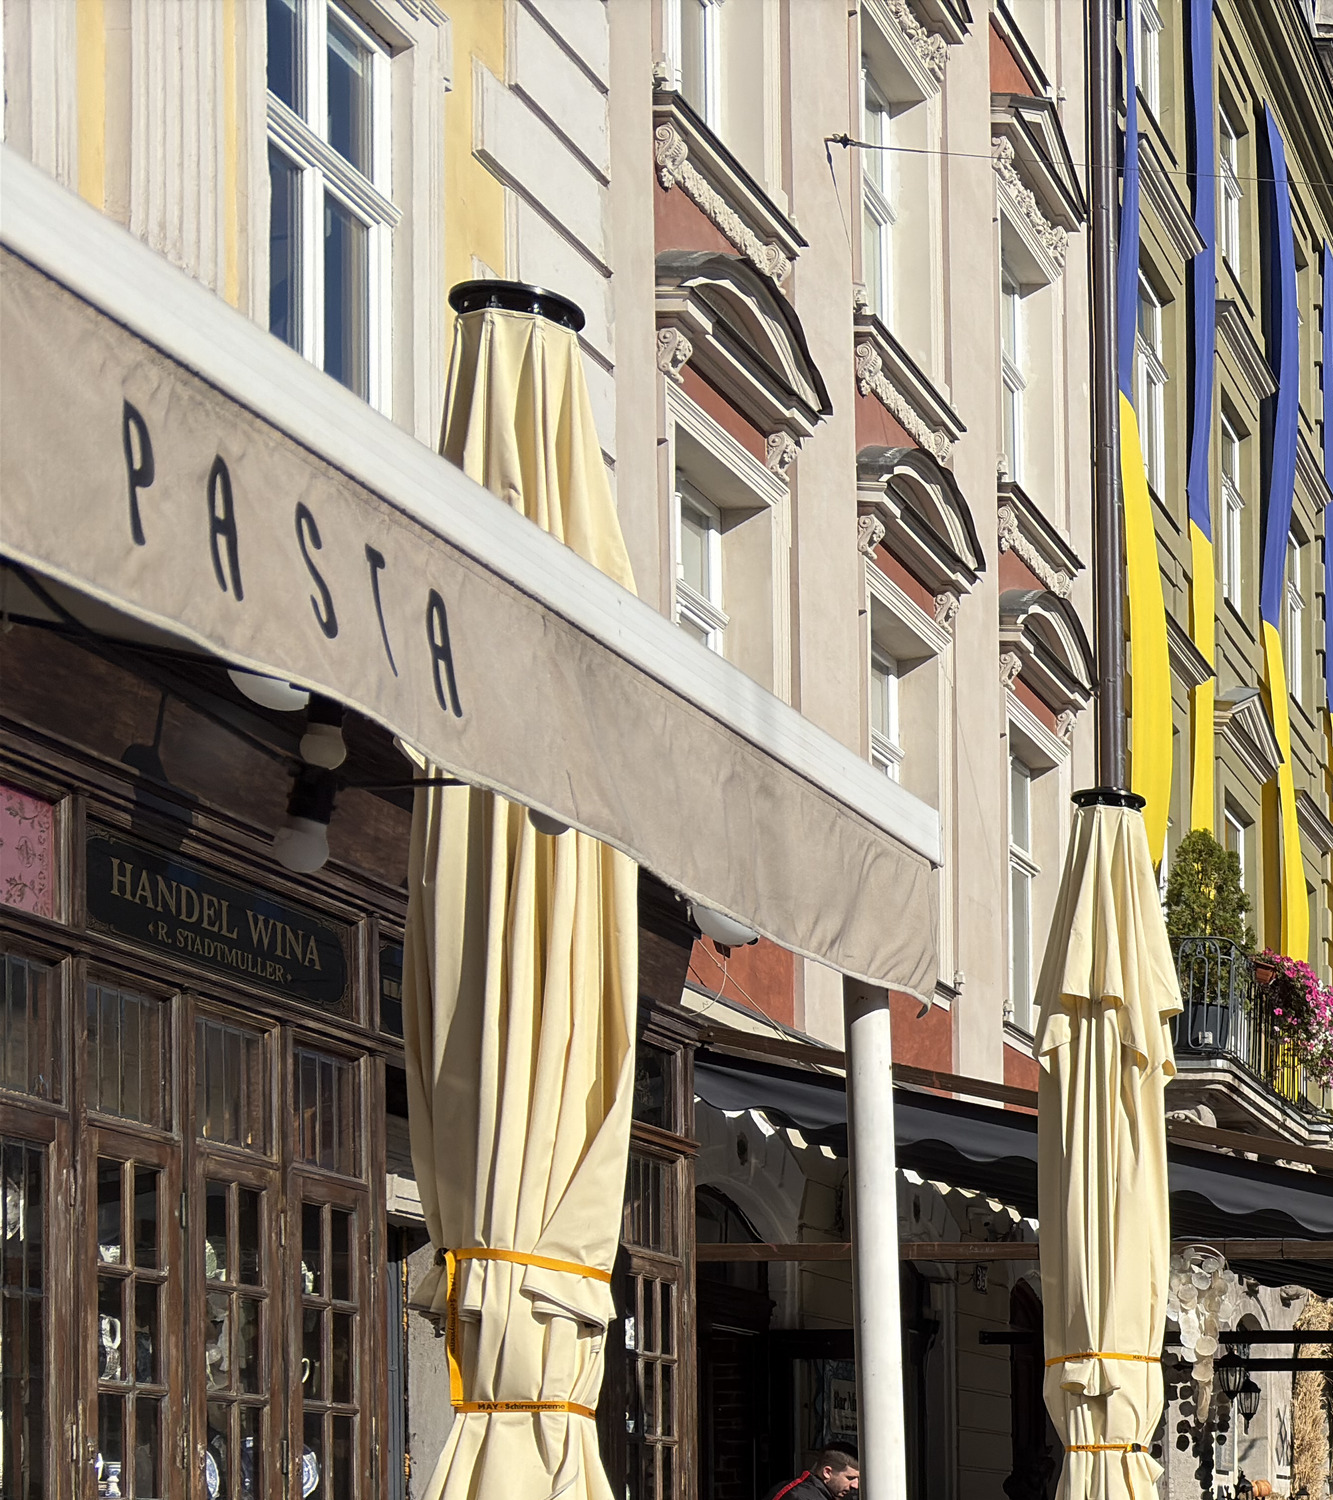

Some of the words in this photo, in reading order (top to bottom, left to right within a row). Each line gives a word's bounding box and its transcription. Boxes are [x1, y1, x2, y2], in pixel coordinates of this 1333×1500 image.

[122, 398, 464, 719] PASTA
[110, 856, 239, 940] HANDEL
[245, 908, 322, 971] WINA
[157, 920, 173, 944] R.
[176, 929, 285, 983] STADTMULLER
[505, 1402, 565, 1411] Schirmsysteme
